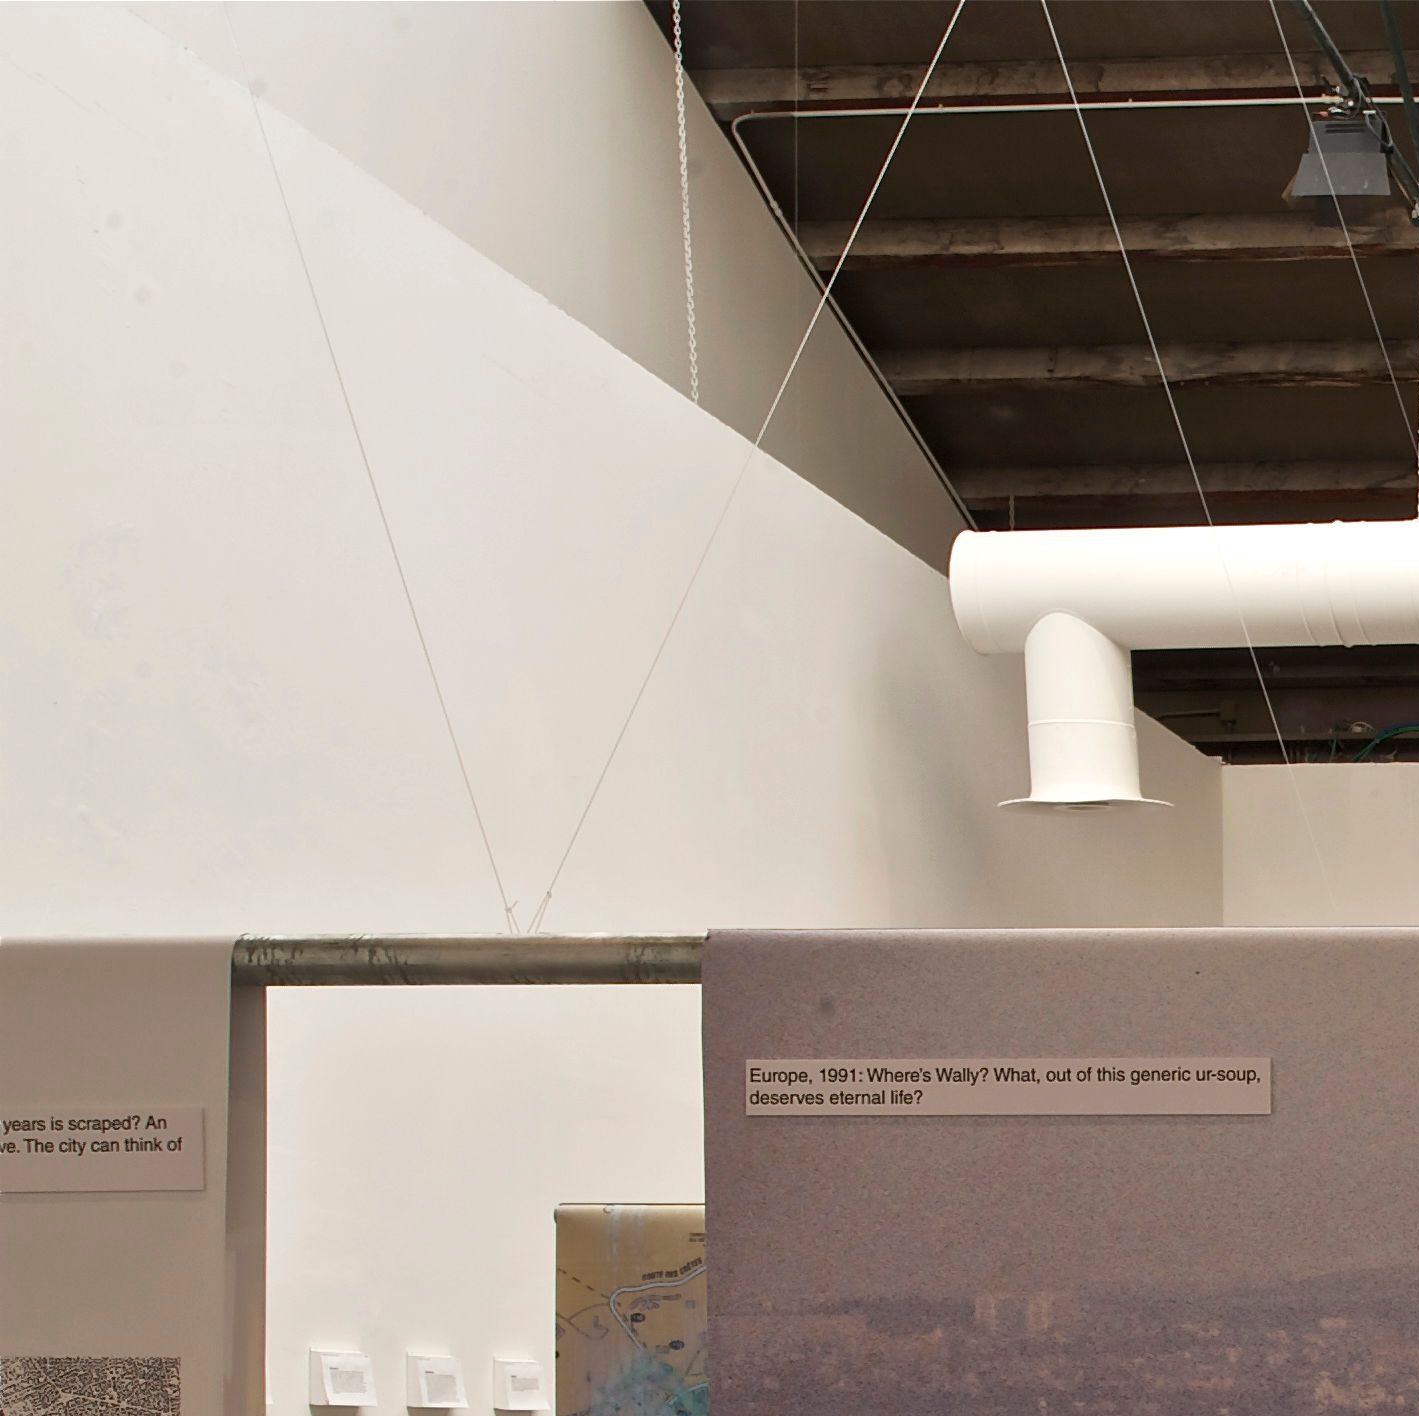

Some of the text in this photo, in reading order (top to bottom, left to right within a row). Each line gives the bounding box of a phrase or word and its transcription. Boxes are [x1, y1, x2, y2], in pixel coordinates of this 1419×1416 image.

[750, 1067, 1260, 1087] Europe, 1991: Where's Wally? What, out of this generic ur-soup,
[750, 1090, 923, 1105] deserves eternal life?
[3, 1115, 167, 1135] years is scraped? An
[0, 1137, 182, 1156] ve. The city can think of
